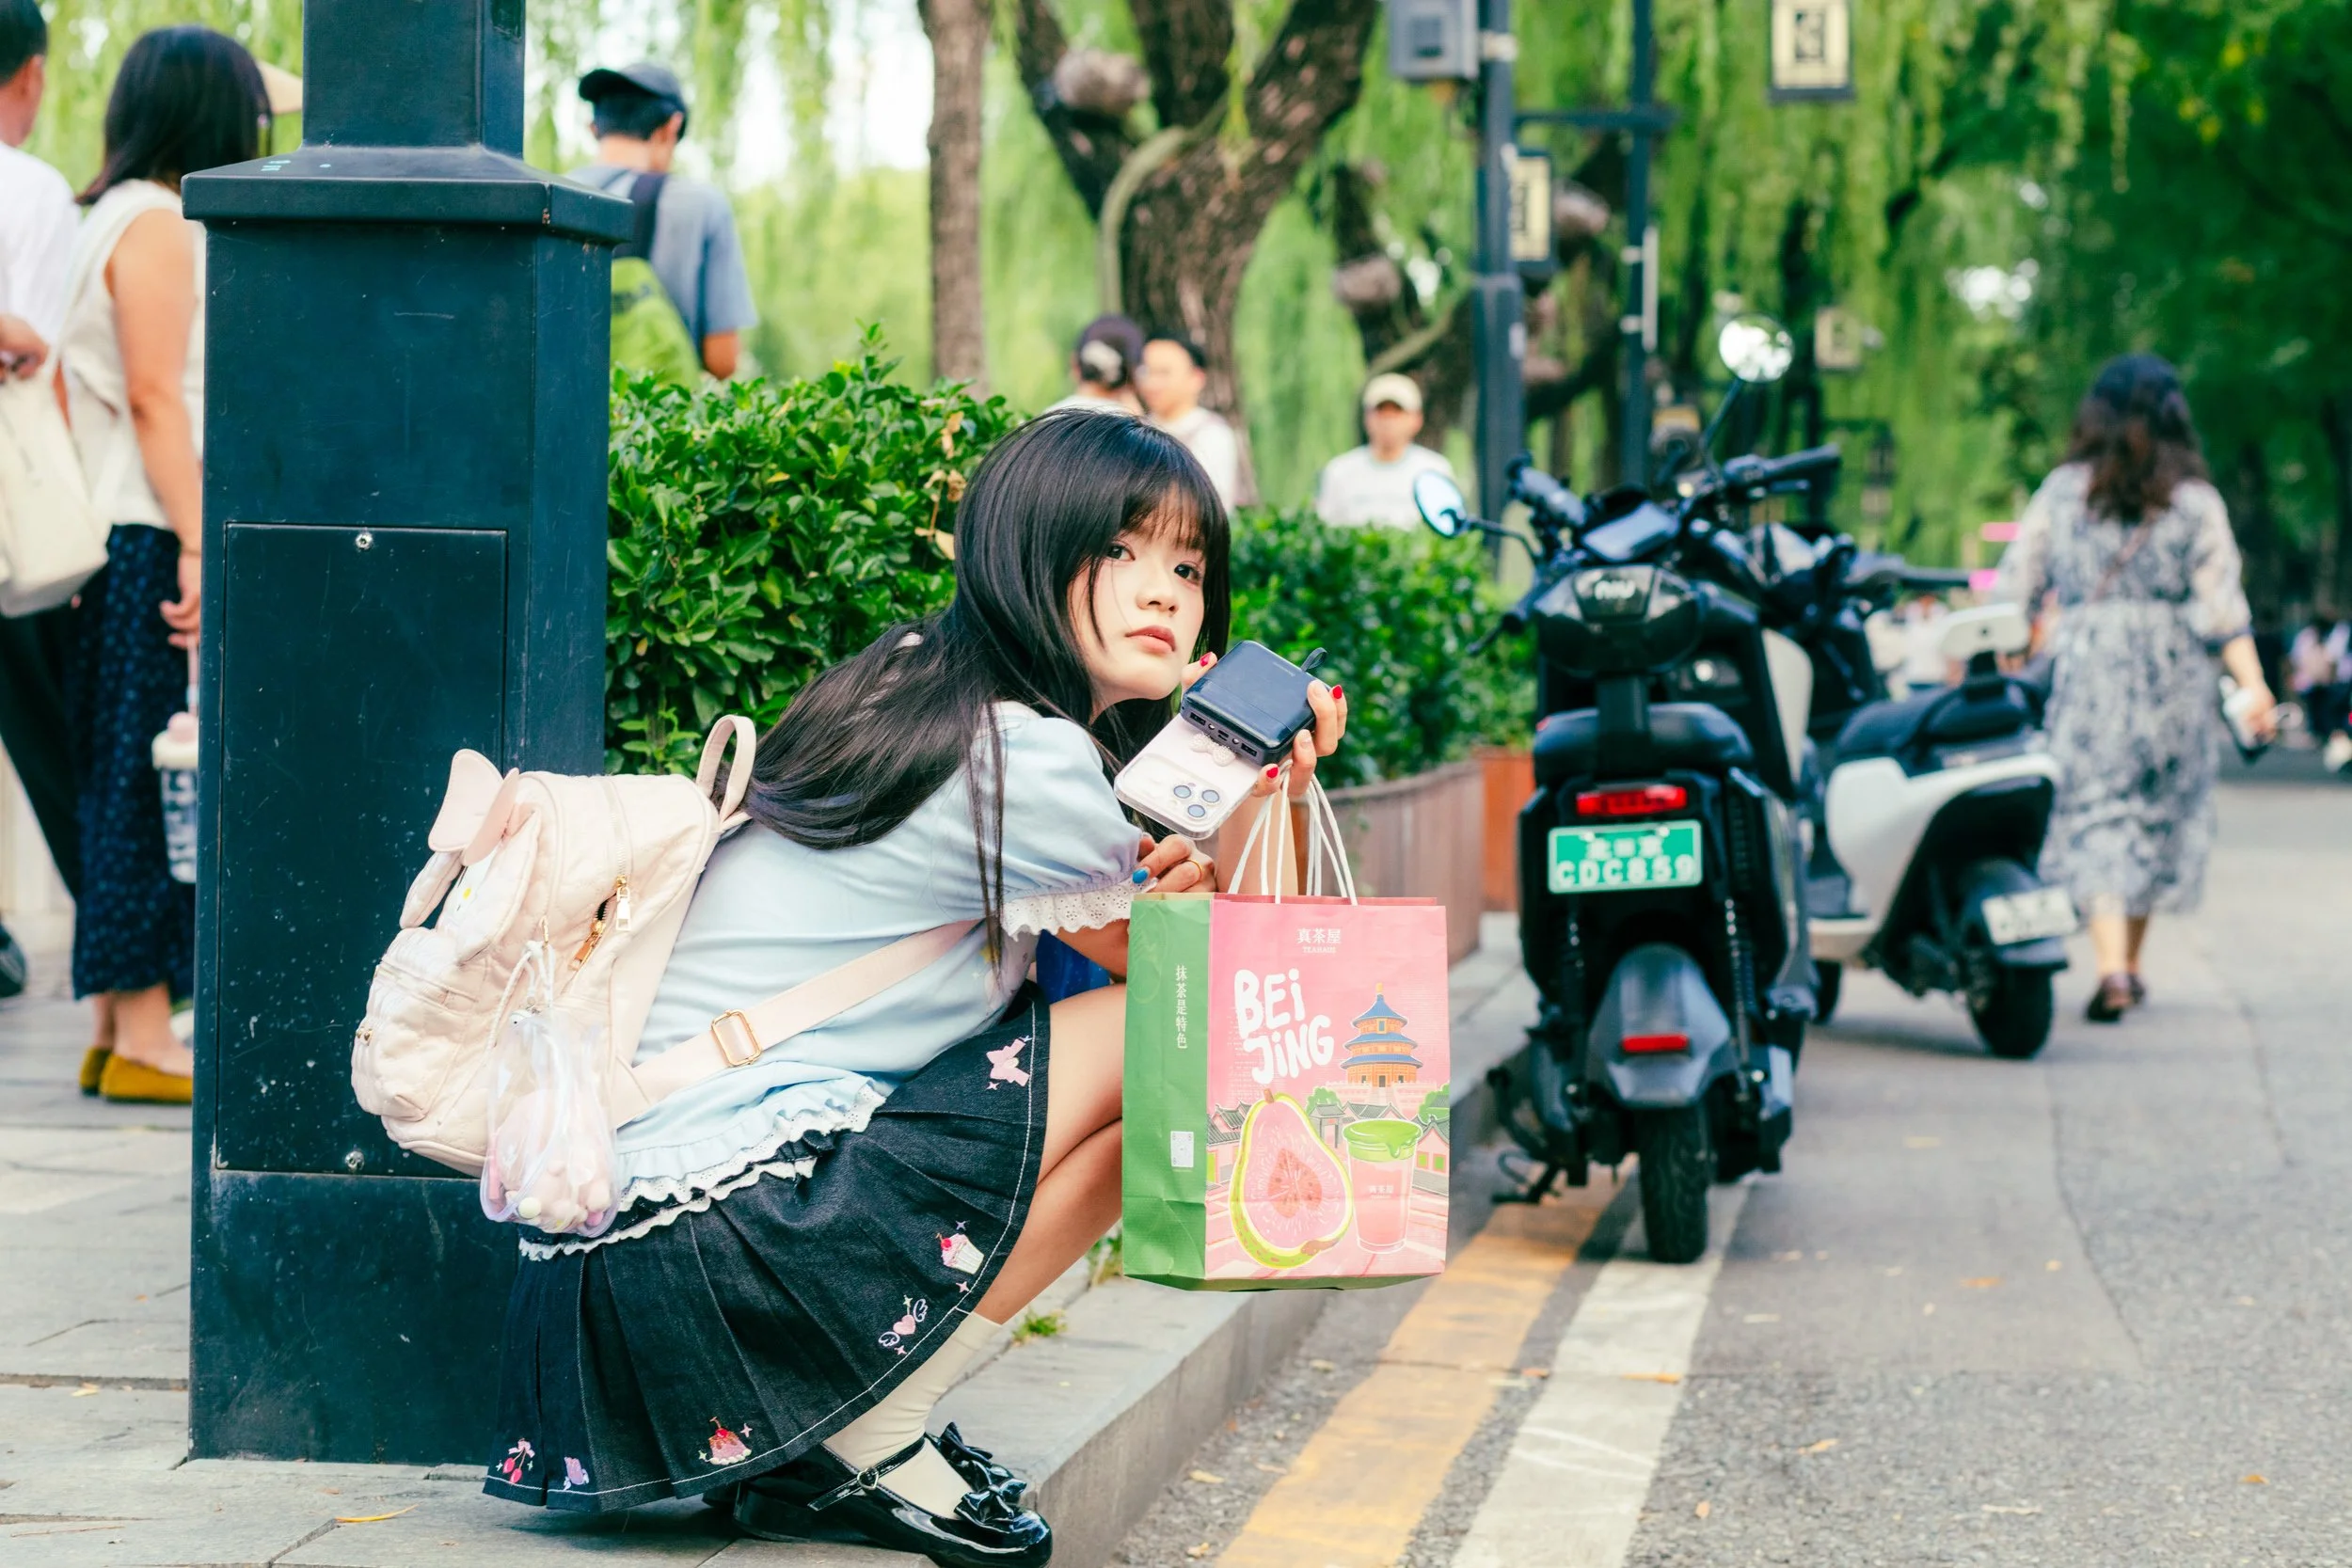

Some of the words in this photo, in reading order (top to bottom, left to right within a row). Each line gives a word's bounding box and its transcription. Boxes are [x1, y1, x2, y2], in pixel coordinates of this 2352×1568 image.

[1296, 927, 1342, 943] 真茶屋
[1175, 964, 1187, 1049] 抹茶是特色
